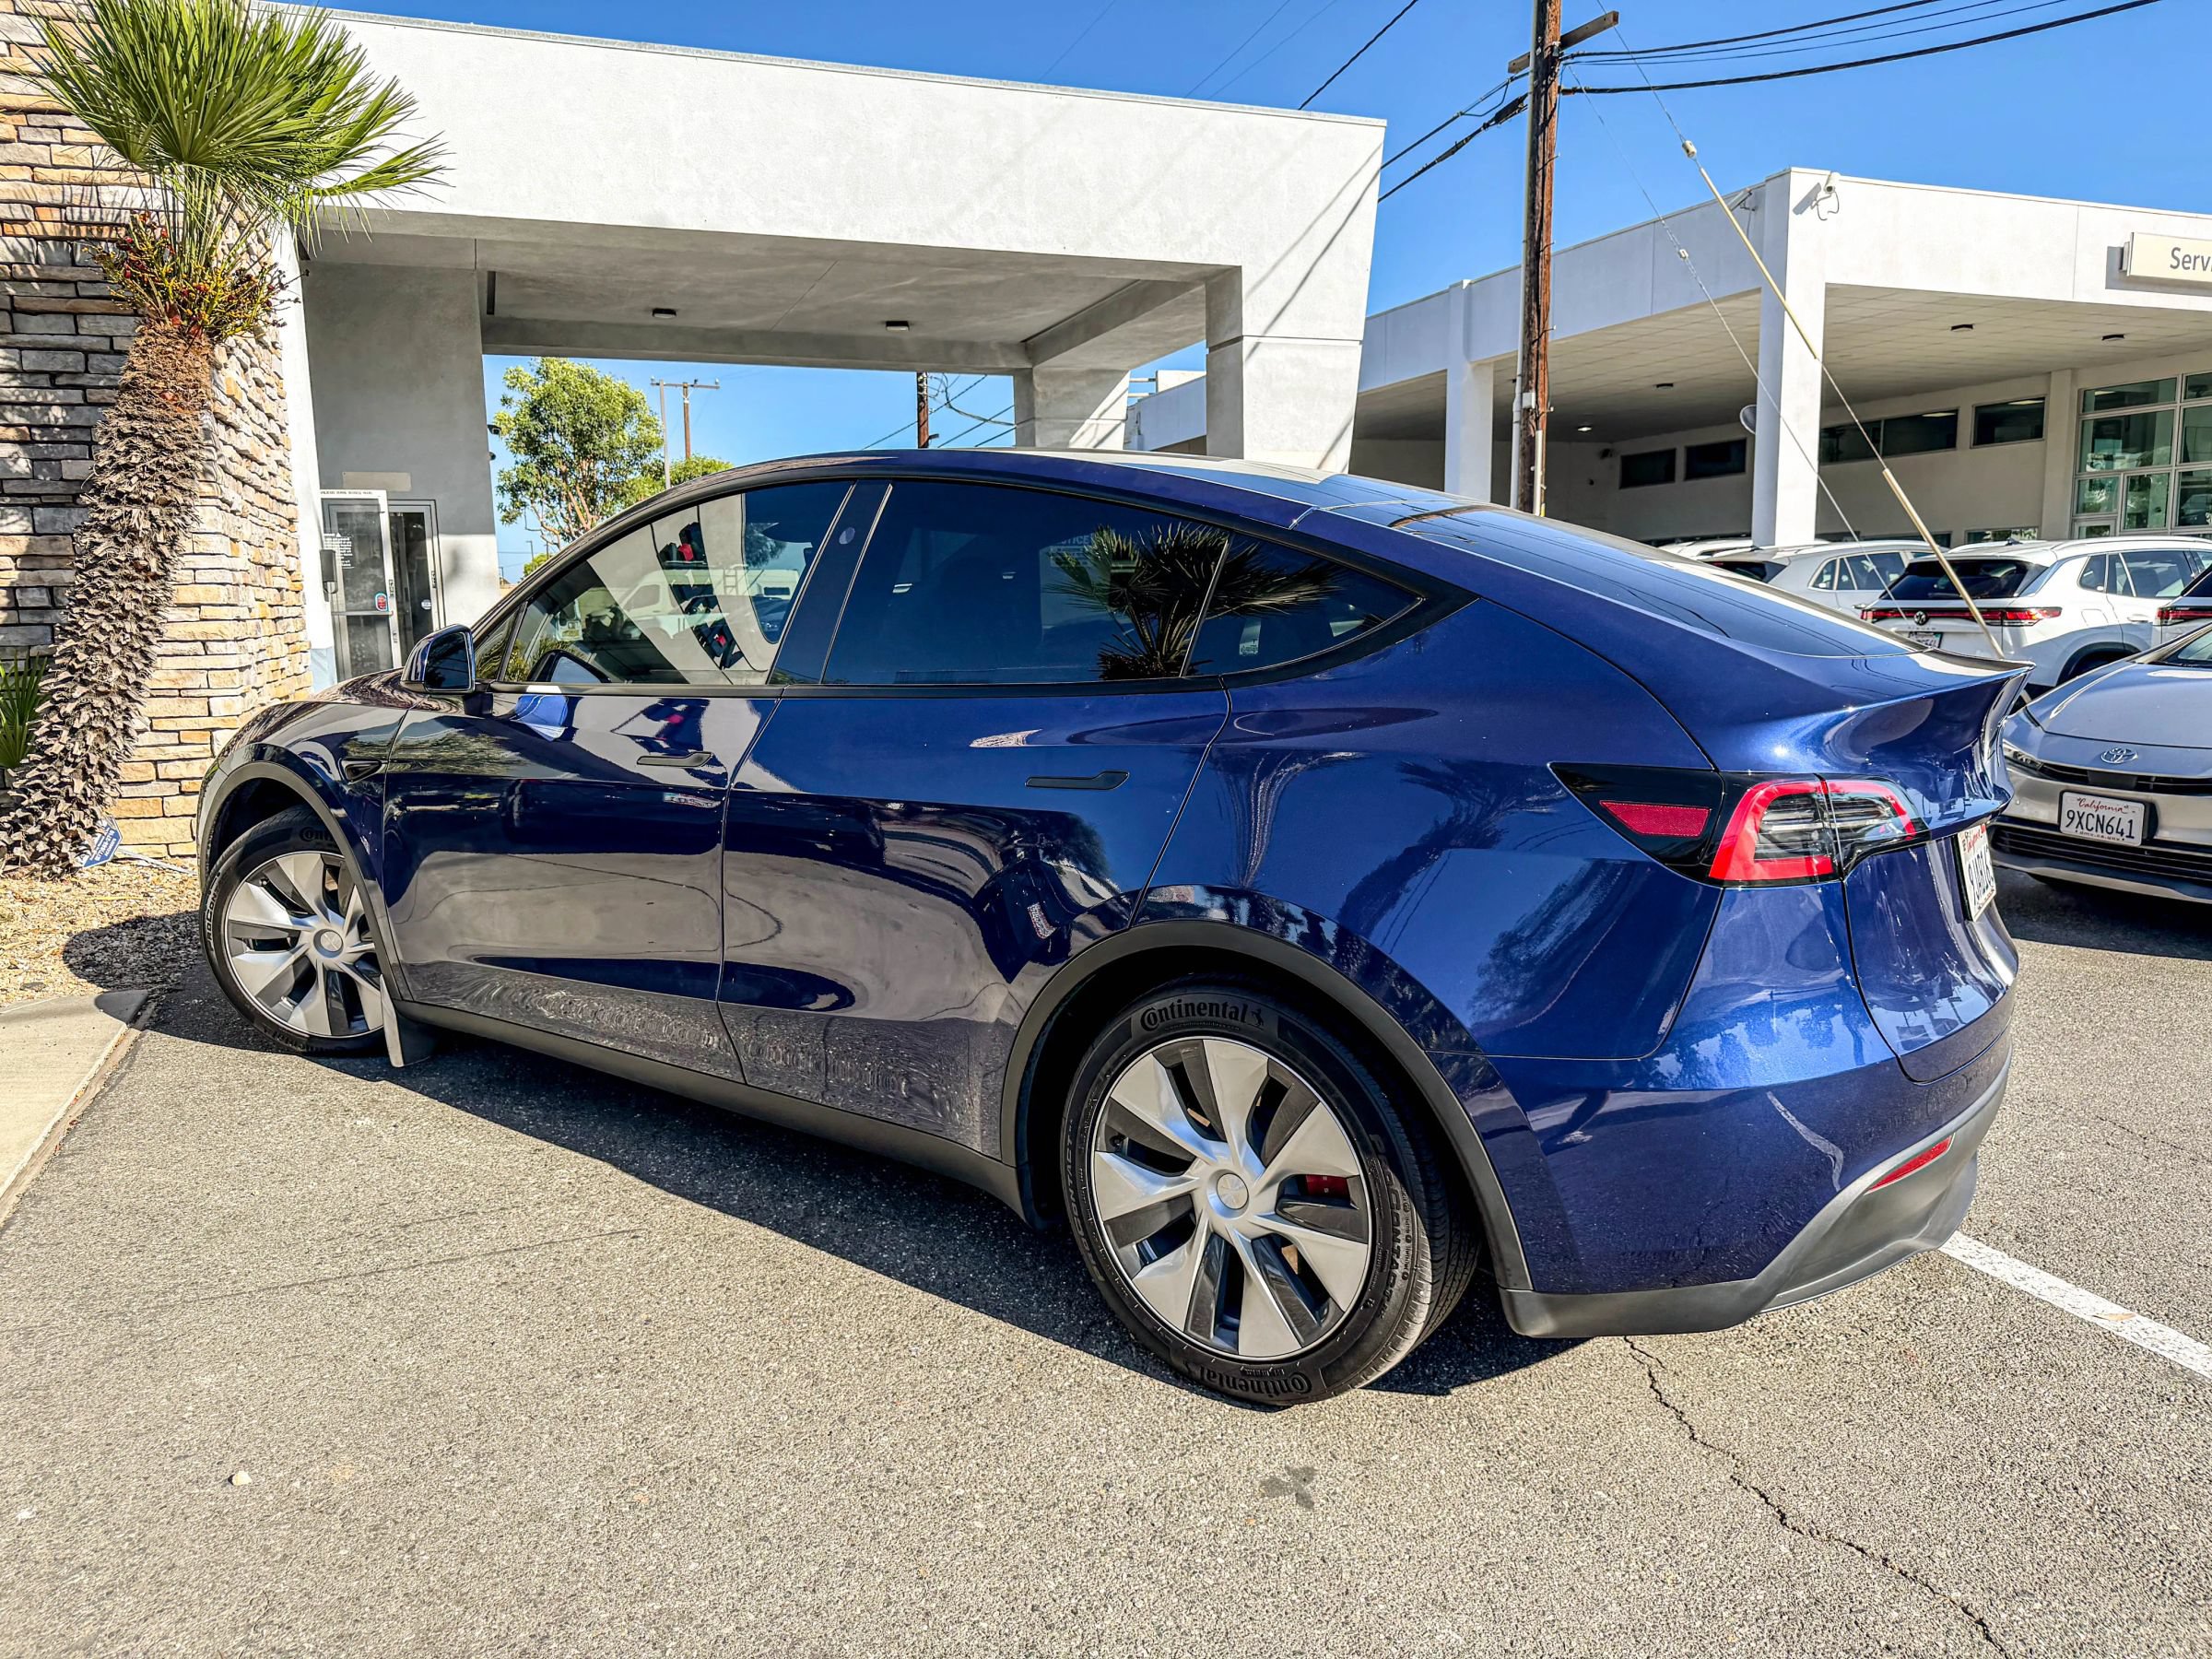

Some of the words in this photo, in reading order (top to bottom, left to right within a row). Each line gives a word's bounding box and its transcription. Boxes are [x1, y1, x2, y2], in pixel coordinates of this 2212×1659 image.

[2170, 246, 2212, 272] Serv
[2078, 797, 2127, 815] California
[2065, 809, 2135, 840] 9XCN641
[1140, 998, 1248, 1031] Continental
[1199, 1365, 1312, 1398] Continental
